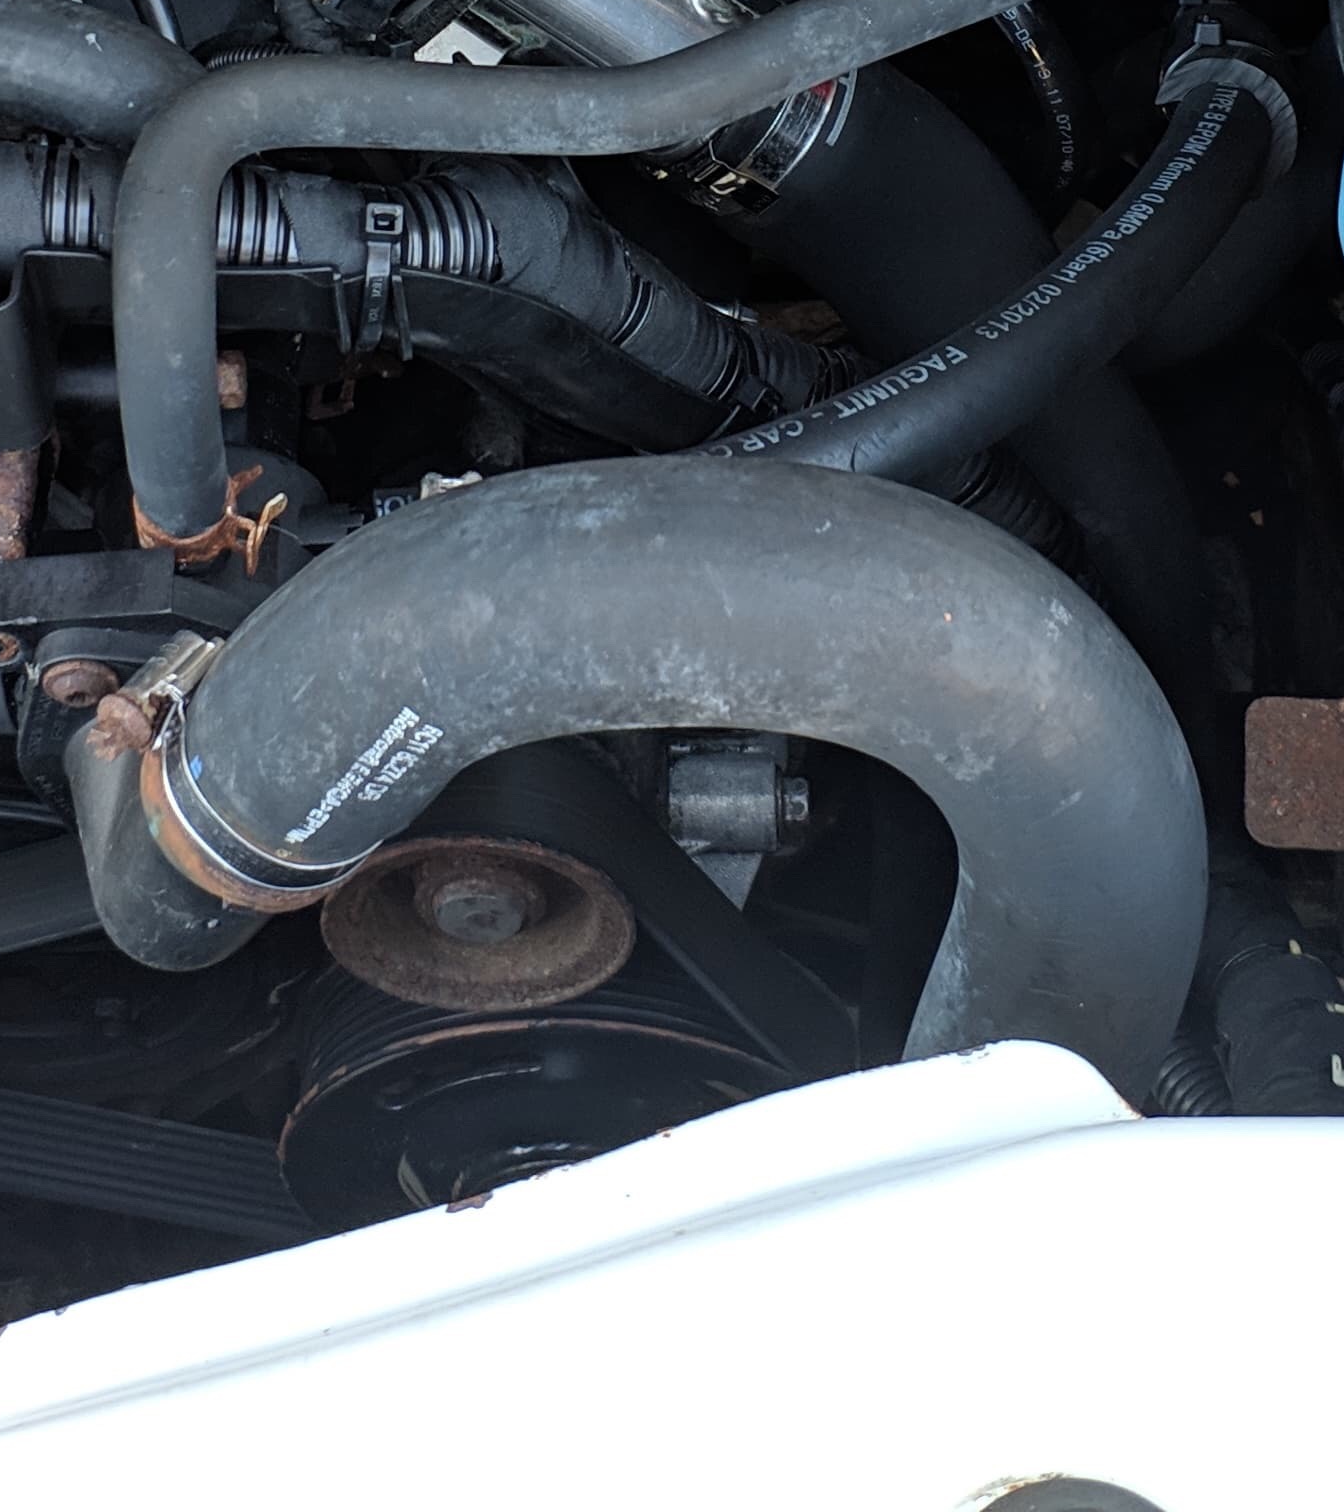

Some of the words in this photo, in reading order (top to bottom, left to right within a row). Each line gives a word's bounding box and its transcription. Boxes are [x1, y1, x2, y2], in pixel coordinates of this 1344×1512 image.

[1149, 154, 1198, 192] 16mm
[975, 283, 1062, 340] 02/2013
[832, 344, 969, 420] FAGUMIT
[741, 419, 805, 453] CAR
